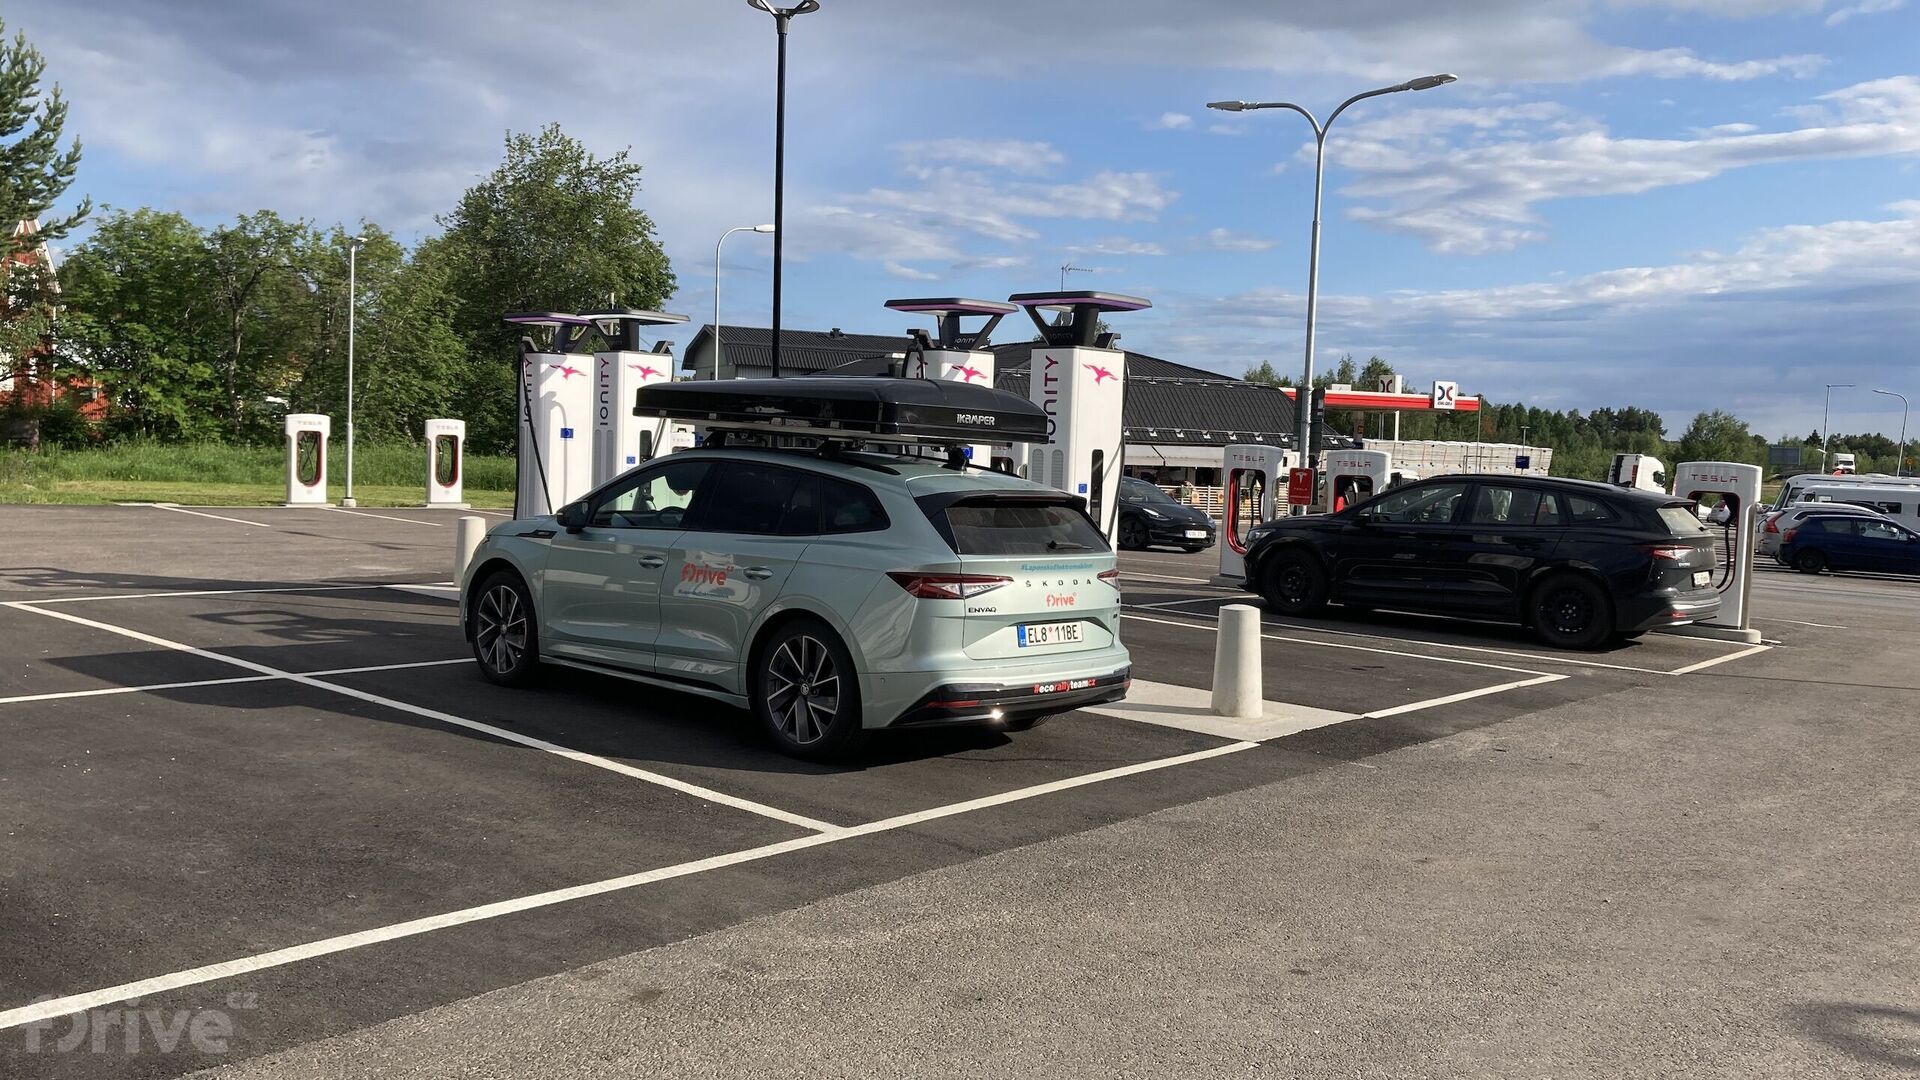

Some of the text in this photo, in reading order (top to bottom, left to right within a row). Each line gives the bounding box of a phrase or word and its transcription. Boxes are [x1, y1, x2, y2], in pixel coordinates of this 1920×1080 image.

[599, 358, 610, 426] IONITY
[1232, 454, 1265, 462] TESLA
[1691, 474, 1738, 483] TESLA
